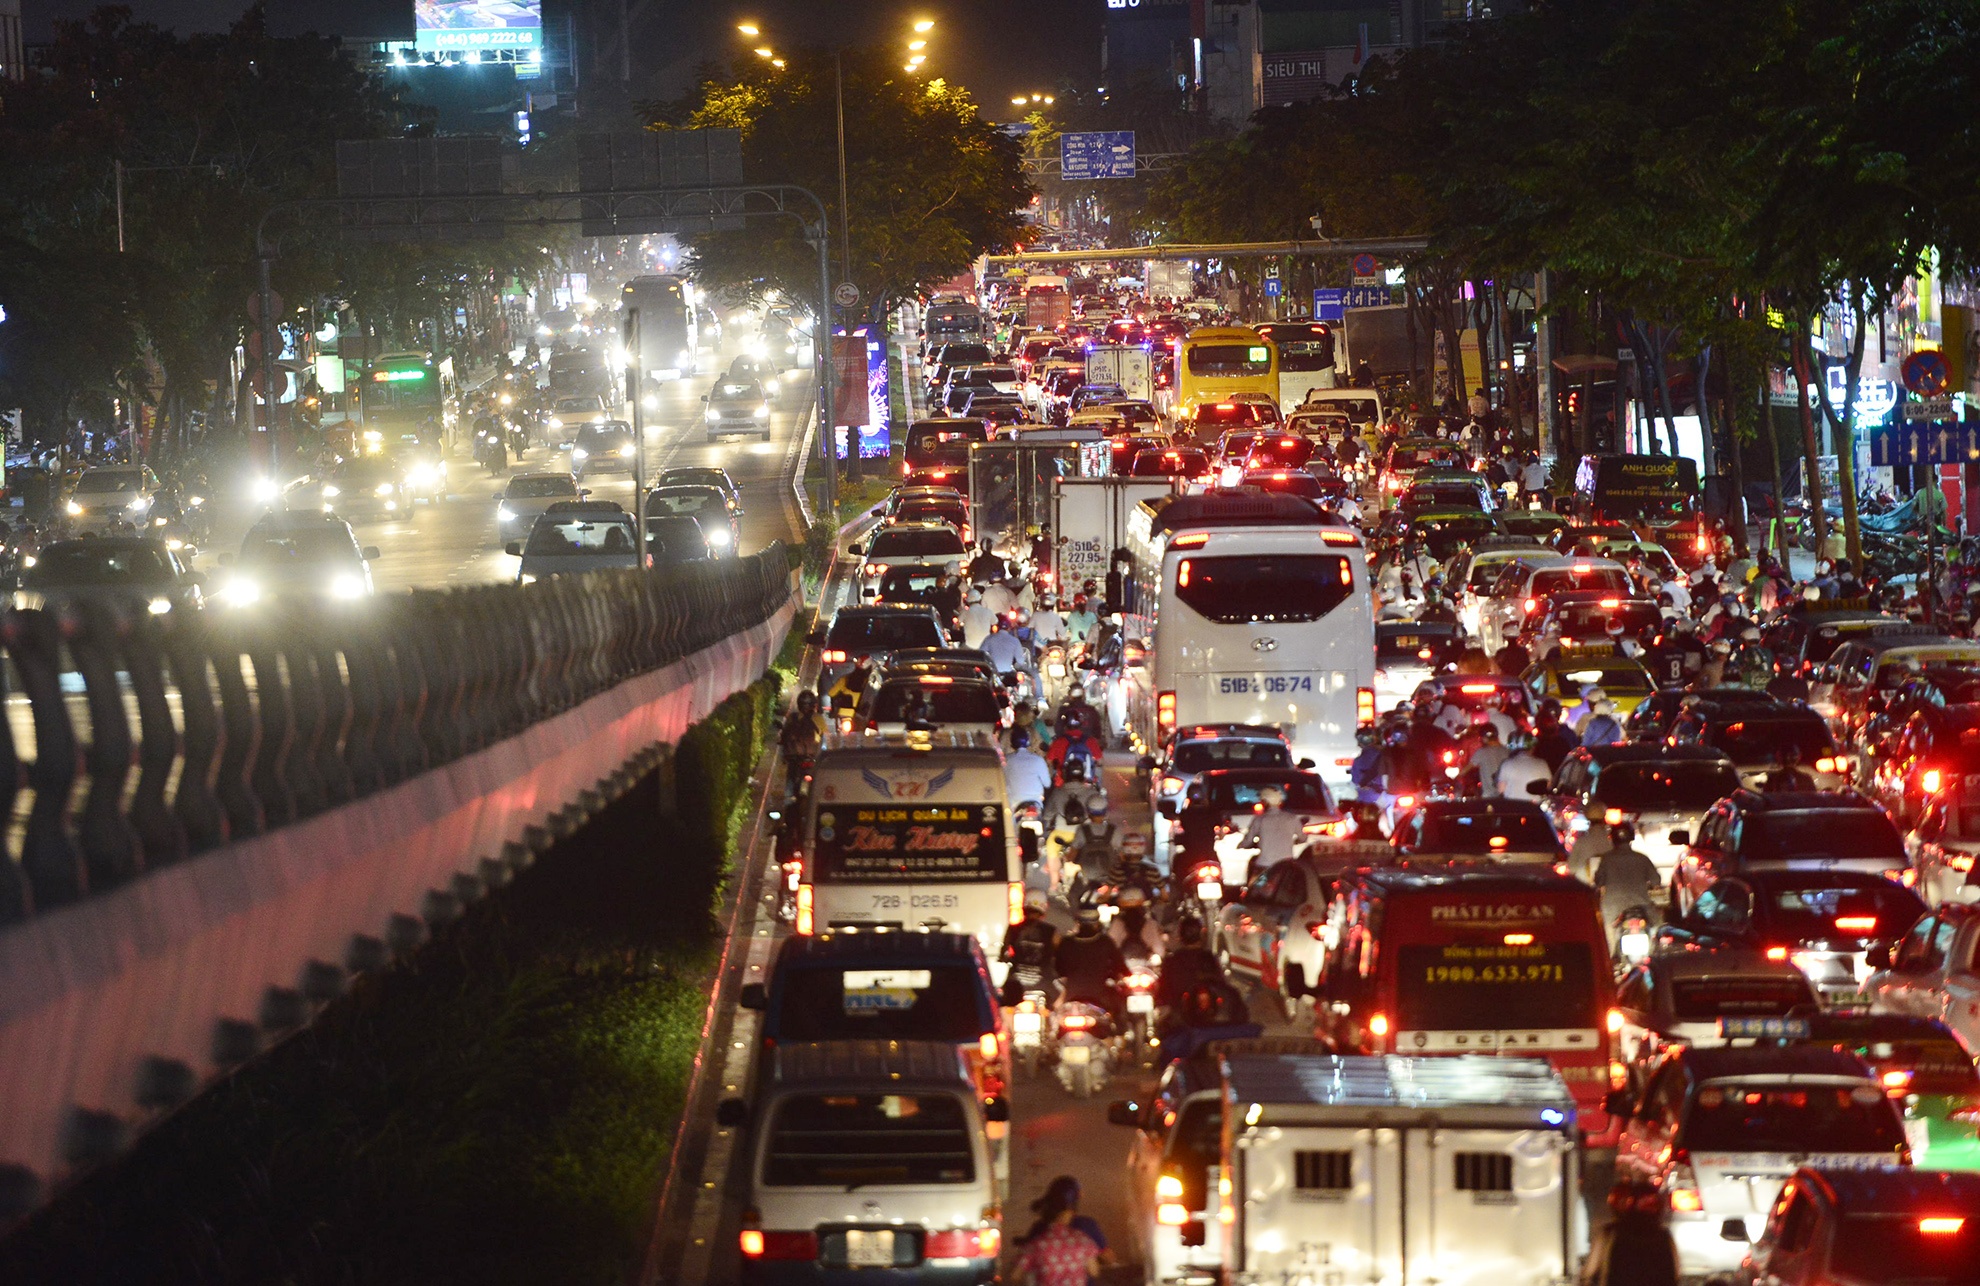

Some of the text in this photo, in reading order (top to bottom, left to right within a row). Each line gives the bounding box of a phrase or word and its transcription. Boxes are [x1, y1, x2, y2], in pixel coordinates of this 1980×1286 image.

[518, 32, 533, 43] 68
[1266, 60, 1321, 79] SIÊU THỊ
[1905, 404, 1951, 416] 6:00-22:00
[923, 440, 936, 450] ups
[1622, 463, 1643, 472] ANH
[1068, 552, 1100, 563] 227.95
[1670, 660, 1680, 679] 8
[857, 810, 876, 821] DU
[1529, 906, 1555, 917] AN
[1426, 964, 1563, 983] 1900.633.971
